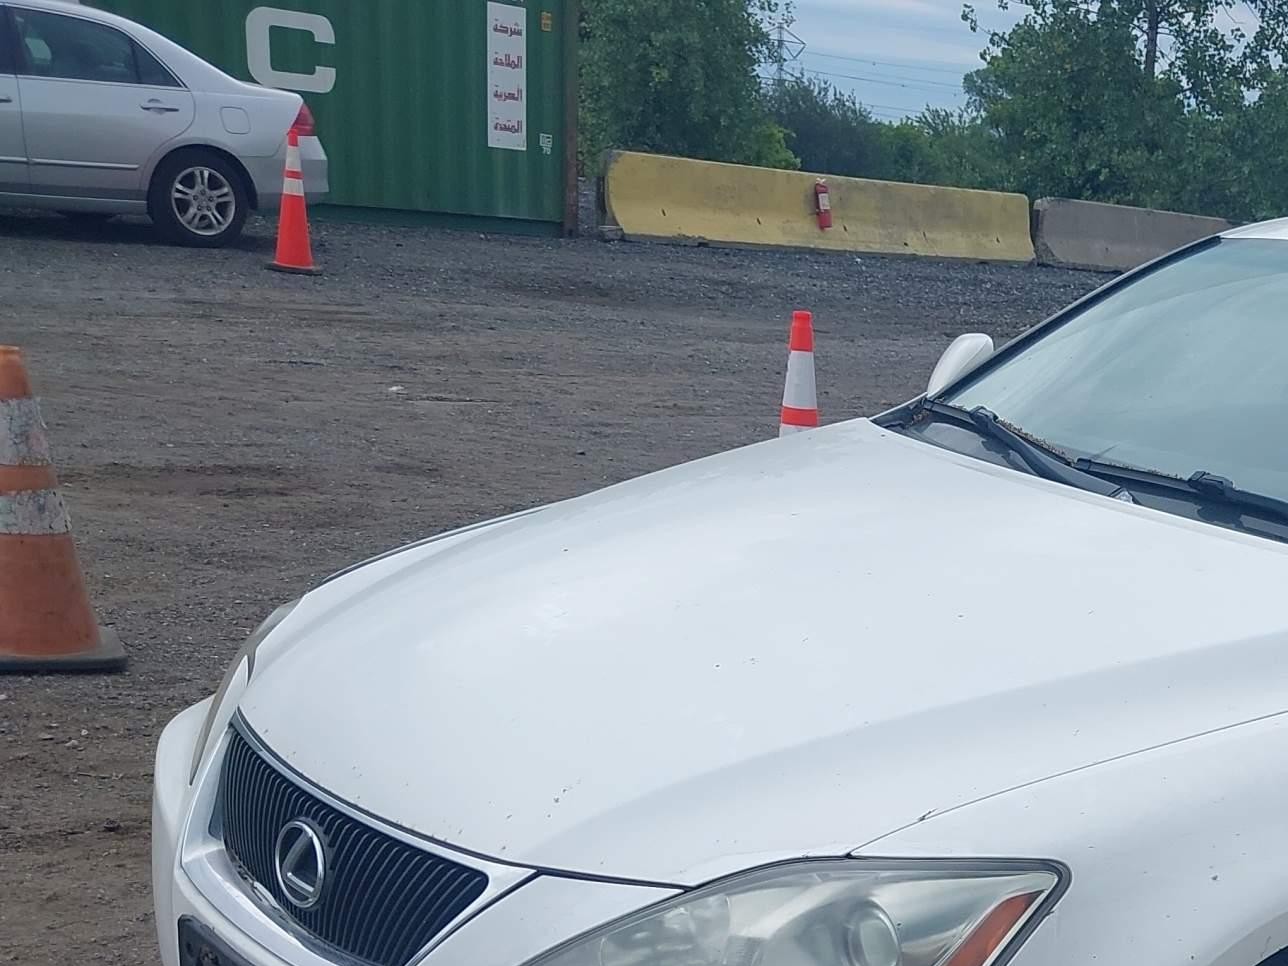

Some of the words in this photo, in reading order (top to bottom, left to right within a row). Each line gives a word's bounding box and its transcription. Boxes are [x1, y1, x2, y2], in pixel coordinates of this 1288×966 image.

[493, 18, 523, 38] شركة
[245, 6, 337, 94] C
[493, 51, 523, 70] الملاحة
[493, 84, 523, 102] العربية
